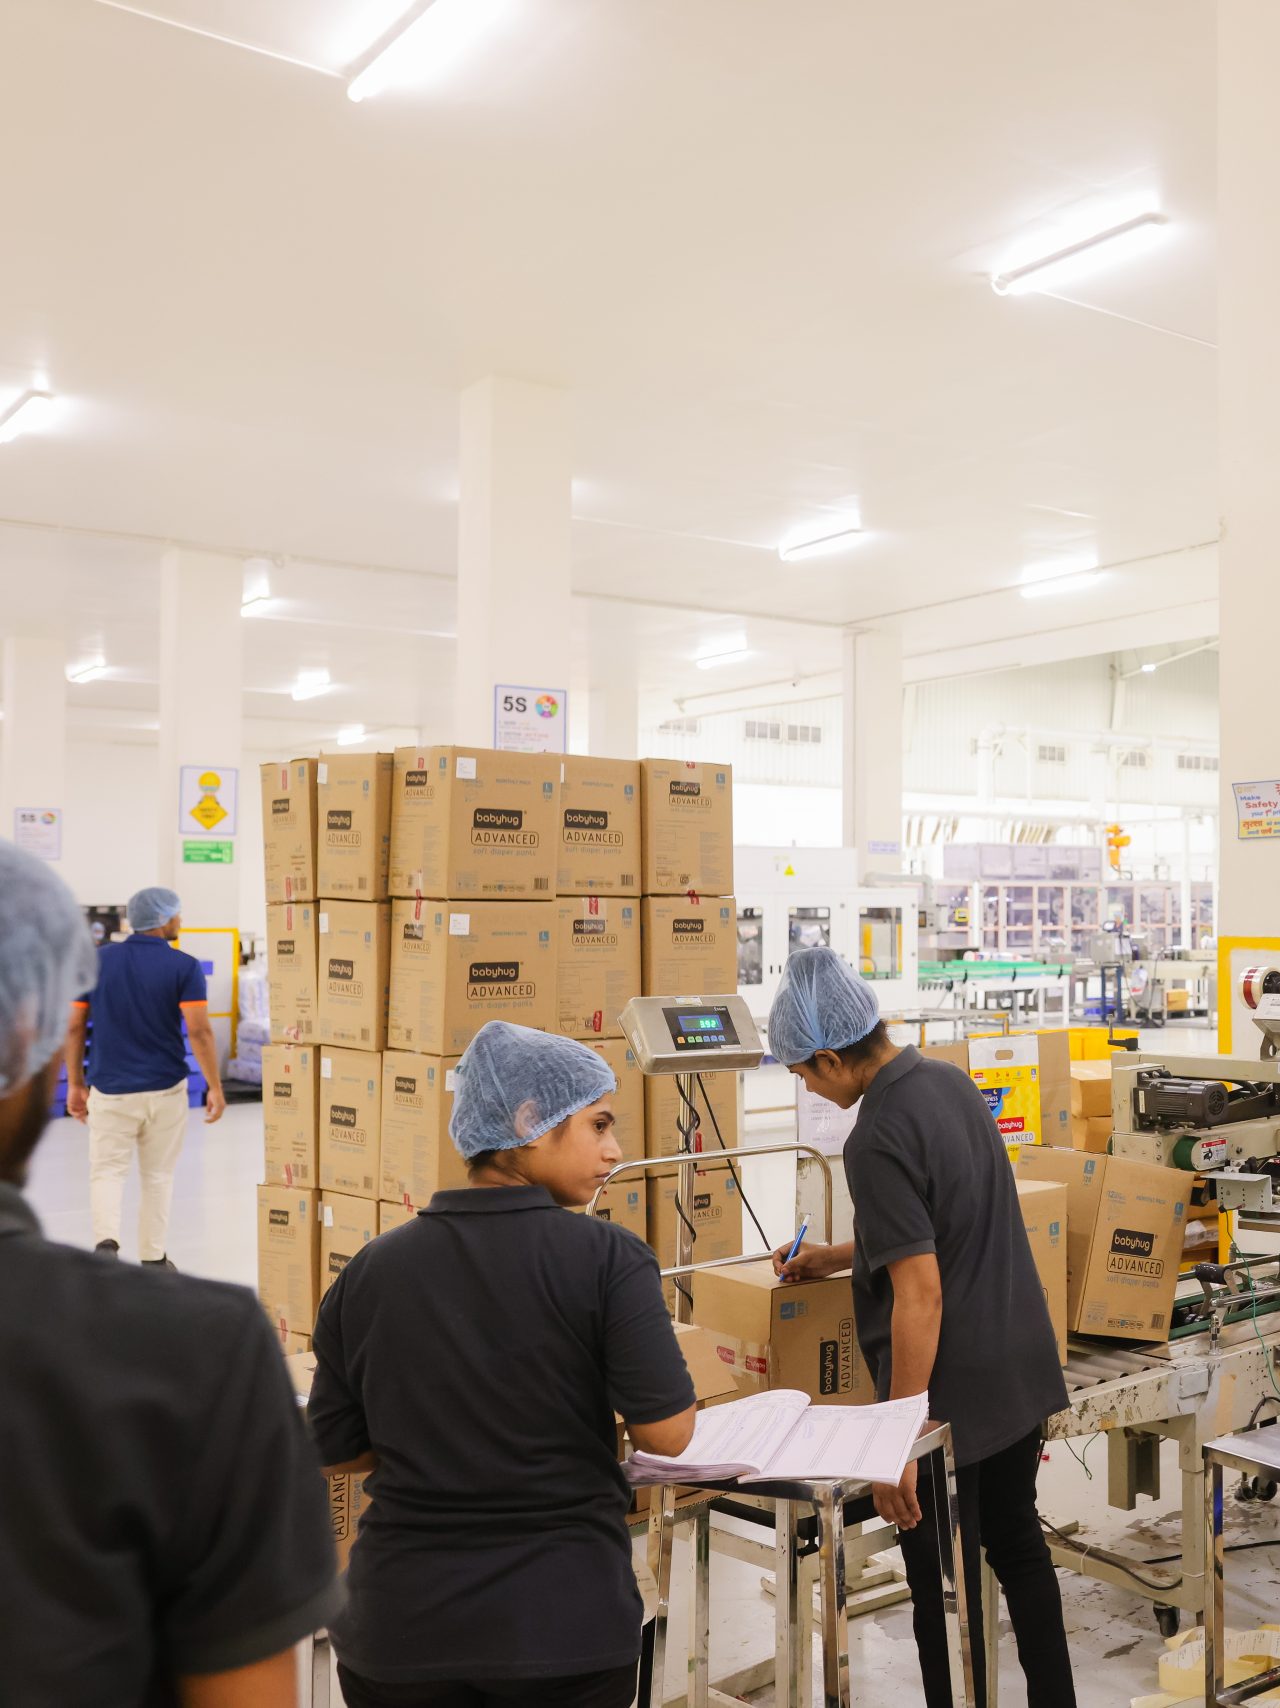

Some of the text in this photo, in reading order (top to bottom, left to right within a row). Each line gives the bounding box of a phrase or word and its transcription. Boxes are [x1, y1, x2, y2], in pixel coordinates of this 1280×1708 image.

[503, 696, 528, 712] 5S
[671, 784, 699, 794] babyhug
[671, 797, 710, 806] ADVANCED
[1245, 801, 1278, 809] Safety
[476, 813, 520, 826] babyhug
[566, 813, 605, 826] babyhug
[327, 833, 360, 845] ADVANCED
[474, 832, 536, 845] ADVANCED
[566, 831, 621, 844] ADVANCED
[574, 922, 604, 931] babyhug
[674, 921, 702, 930] babyhug
[575, 935, 616, 944] ADVANCED
[674, 935, 714, 943] ADVANCED
[471, 966, 516, 978] babyhug
[329, 981, 362, 995] ADVANCED
[470, 984, 532, 997] ADVANCED
[395, 1095, 423, 1106] ADVANCED
[331, 1110, 354, 1124] babyhug
[998, 1121, 1022, 1129] babyhug
[331, 1128, 365, 1143] ADVANCED
[1003, 1132, 1034, 1143] DVANCED
[694, 1207, 720, 1219] VANCED
[1114, 1233, 1150, 1251] babyhug
[1110, 1257, 1161, 1275] ADVANCED
[1121, 1276, 1140, 1287] diaper
[1142, 1279, 1159, 1288] pants
[841, 1321, 851, 1389] ADVANCED
[824, 1344, 835, 1392] babyhug
[332, 1472, 345, 1536] ADVANC
